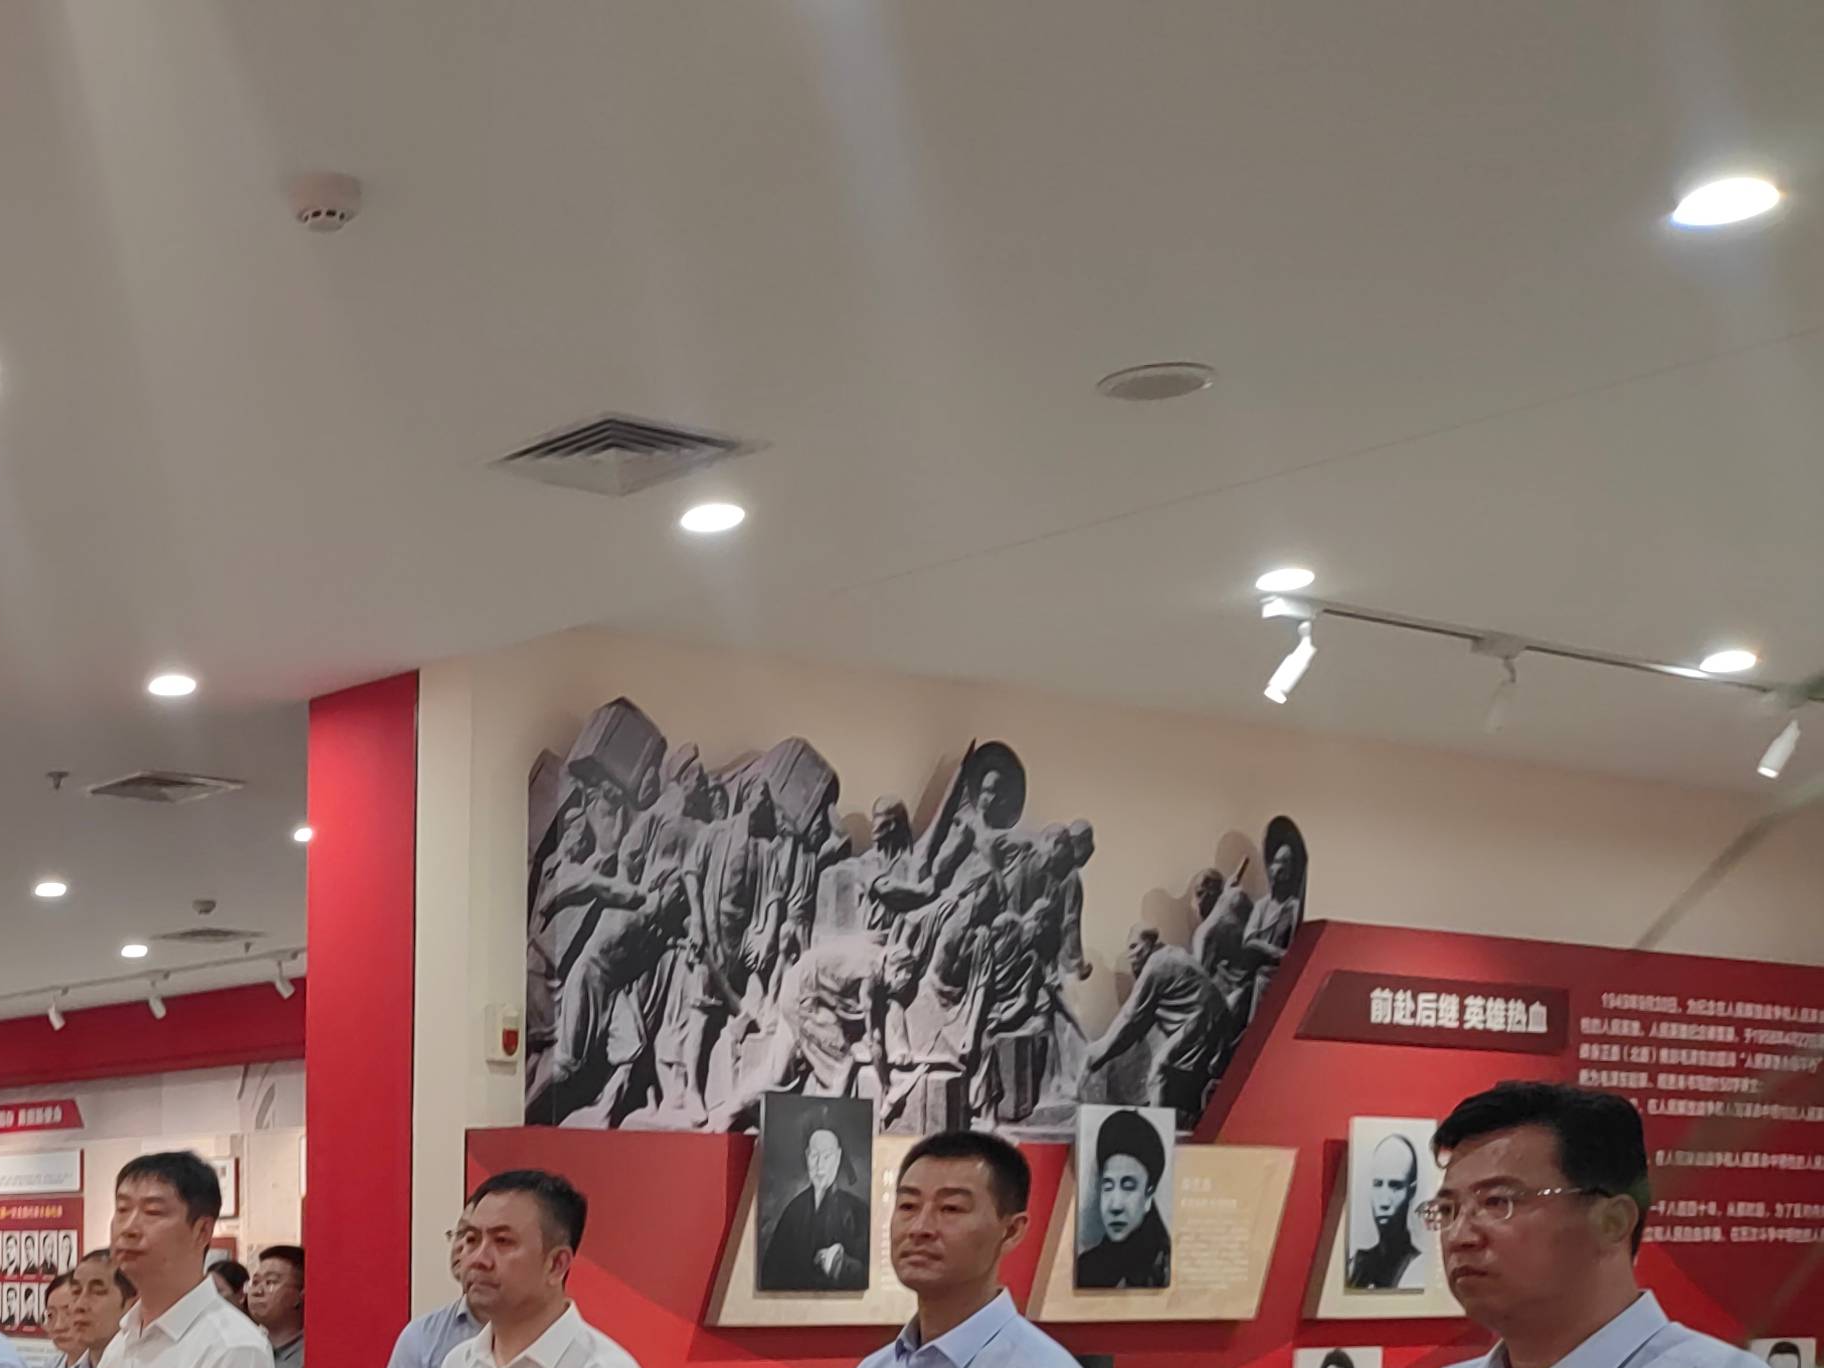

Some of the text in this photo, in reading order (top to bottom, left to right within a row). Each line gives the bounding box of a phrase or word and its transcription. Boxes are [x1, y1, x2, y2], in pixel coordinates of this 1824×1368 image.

[1370, 987, 1460, 1029] 前赴后继
[1463, 994, 1548, 1034] 英雄热血
